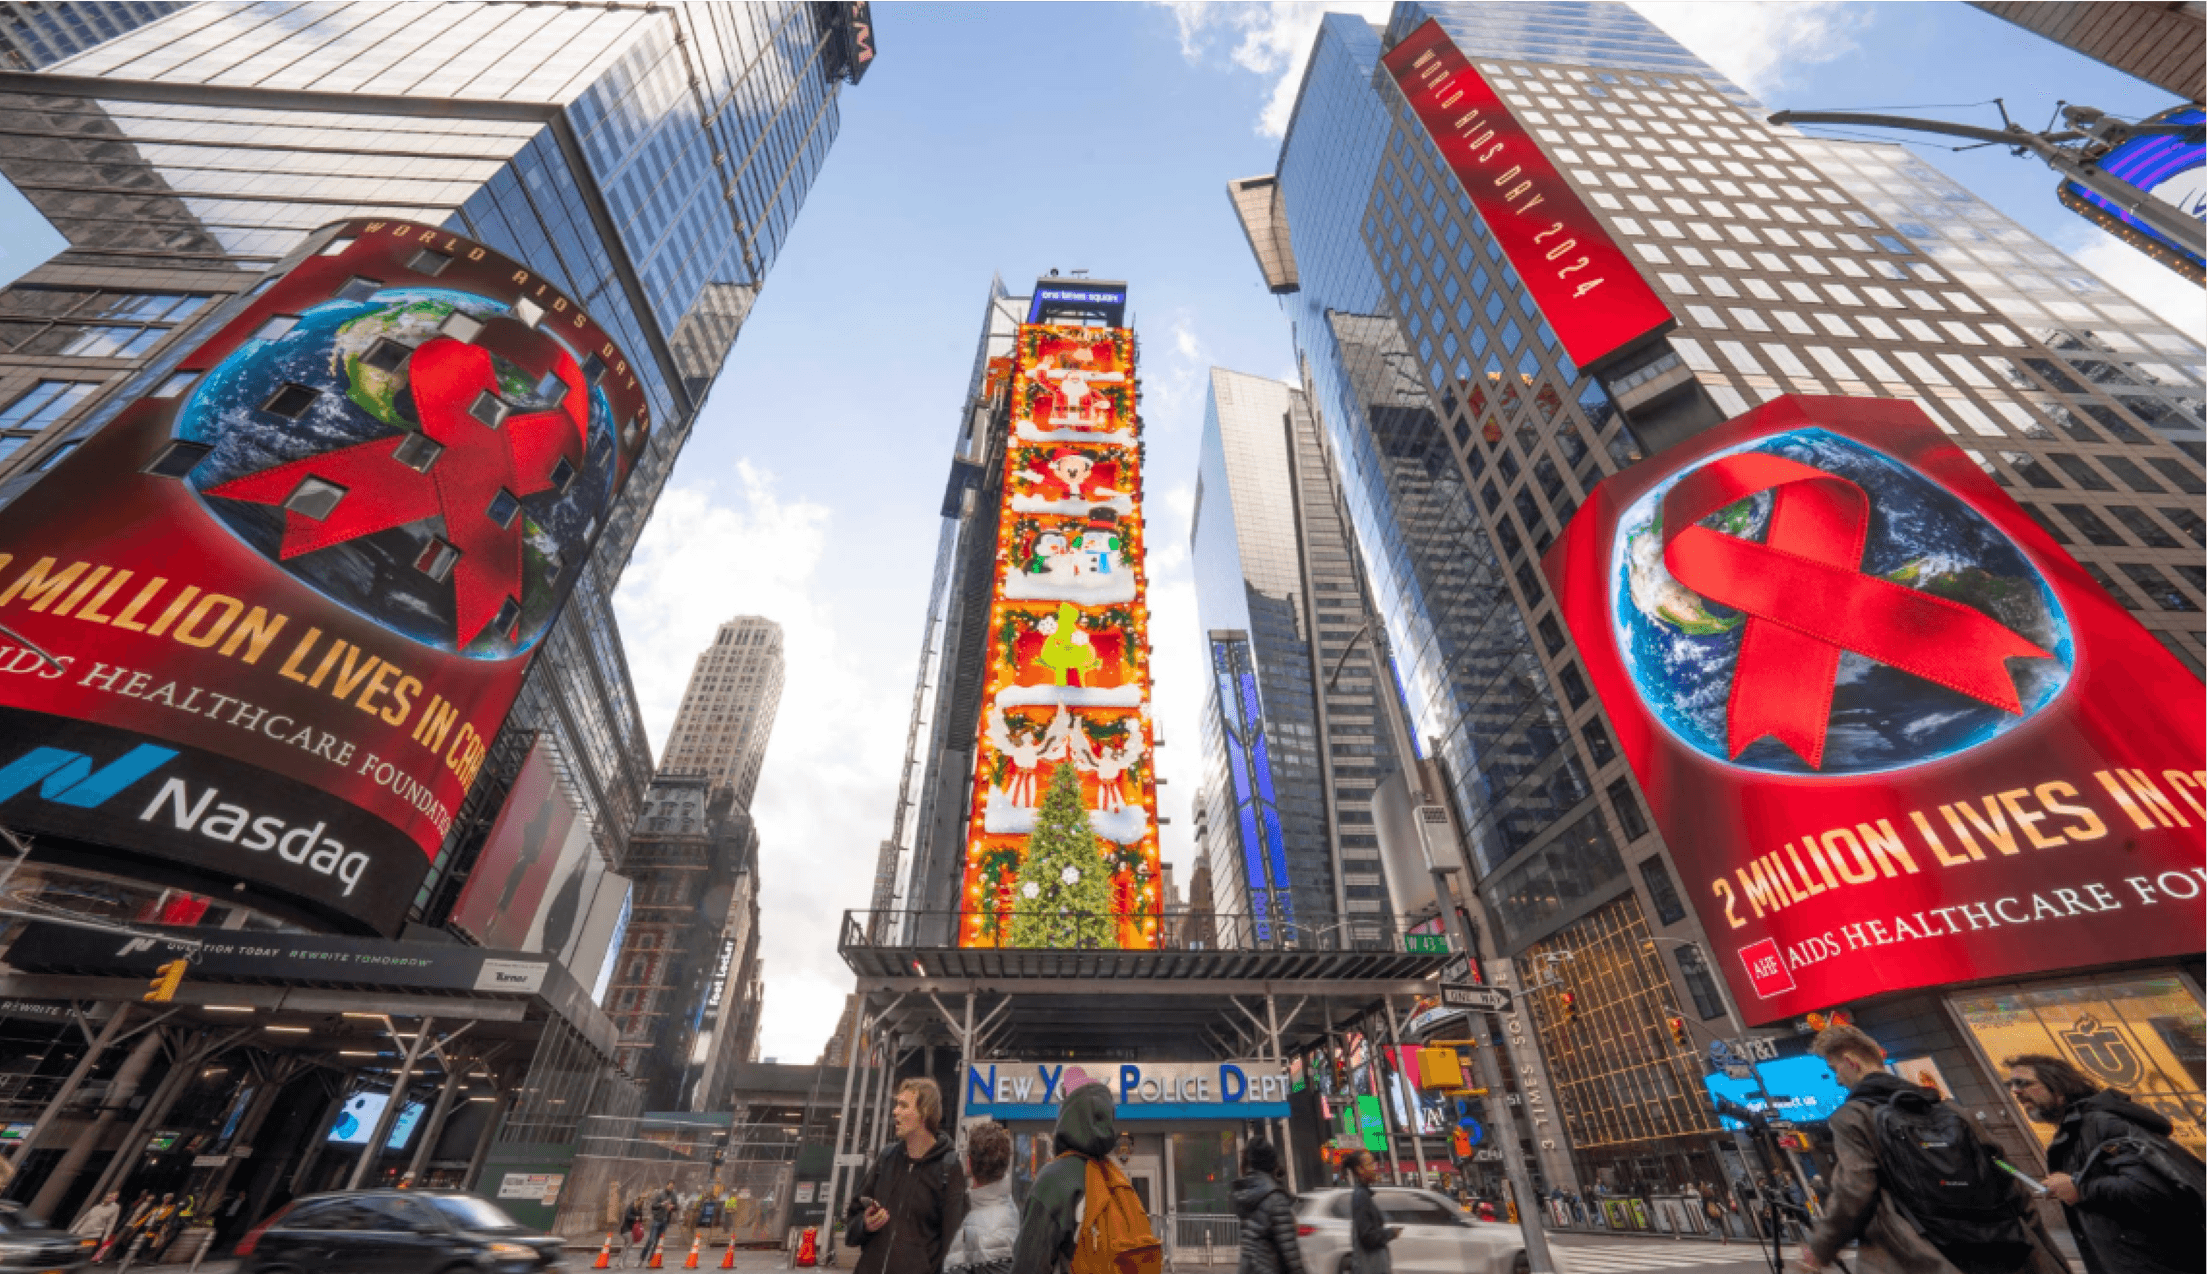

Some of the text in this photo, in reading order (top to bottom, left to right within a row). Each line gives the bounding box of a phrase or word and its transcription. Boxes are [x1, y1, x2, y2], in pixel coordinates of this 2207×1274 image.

[1413, 49, 1604, 299] WORLD AIDS DAY 2024
[365, 221, 486, 261] WORLD
[512, 270, 587, 328] AIDS
[602, 342, 635, 391] DAY
[0, 556, 289, 665] MILLION
[278, 626, 423, 727] LIVES
[411, 693, 459, 753] IN
[0, 645, 75, 680] IDS
[77, 662, 356, 766] HEALTHCARE
[139, 777, 370, 897] Nasdaq
[1712, 876, 1748, 930] 2
[1735, 818, 1920, 919] MILLION
[1908, 780, 2108, 868] LIVES
[2093, 769, 2192, 831] IN
[709, 940, 734, 1006] Foot Locker
[1753, 955, 1779, 980] AHF
[1788, 931, 1841, 970] AIDS
[1840, 882, 2122, 950] HEALTHCARE
[1119, 1064, 1209, 1104] POLICE
[1521, 1064, 1549, 1127] TIMES
[1541, 1138, 1556, 1151] 3
